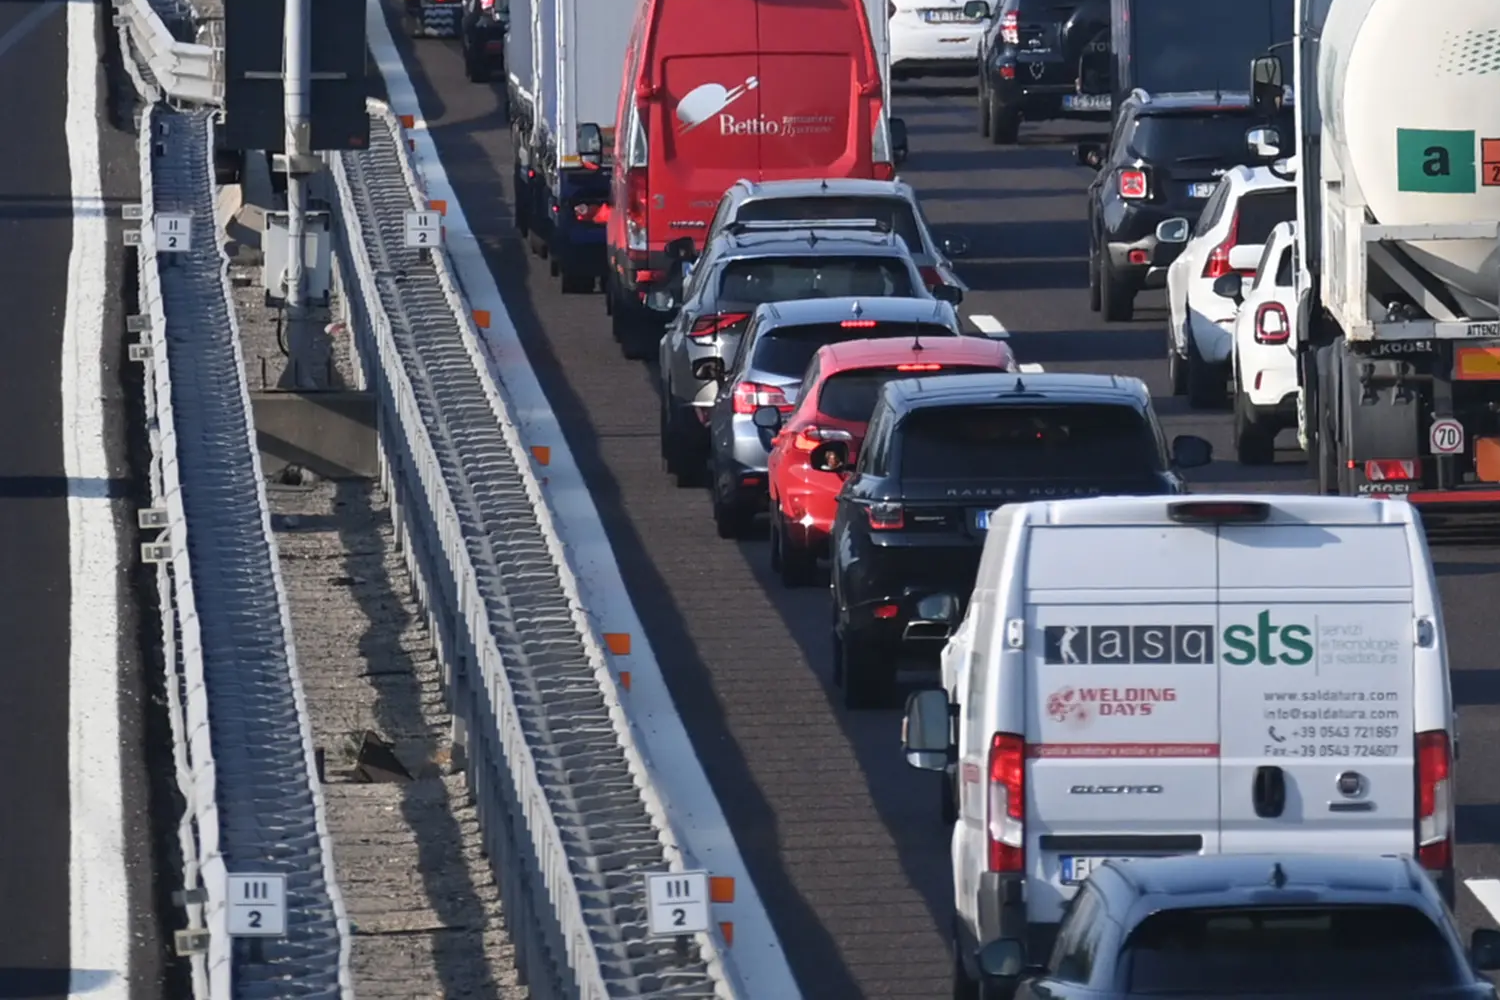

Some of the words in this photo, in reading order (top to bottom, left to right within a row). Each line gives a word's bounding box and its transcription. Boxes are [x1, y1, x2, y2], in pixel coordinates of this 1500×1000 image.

[719, 113, 779, 136] Bettio
[1422, 146, 1450, 176] a
[168, 237, 178, 248] 2
[418, 232, 428, 244] 2
[1438, 428, 1456, 447] 70
[1222, 609, 1315, 667] sts
[1078, 687, 1177, 702] WELDING
[1263, 689, 1398, 701] www.saldatura.com
[1098, 703, 1152, 716] DAYS
[1263, 707, 1399, 719] info@saldatura.com
[1291, 725, 1316, 738] +39
[1320, 725, 1350, 738] 0543
[1319, 744, 1350, 757] 0543
[247, 911, 262, 928] 2
[671, 908, 686, 926] 2
